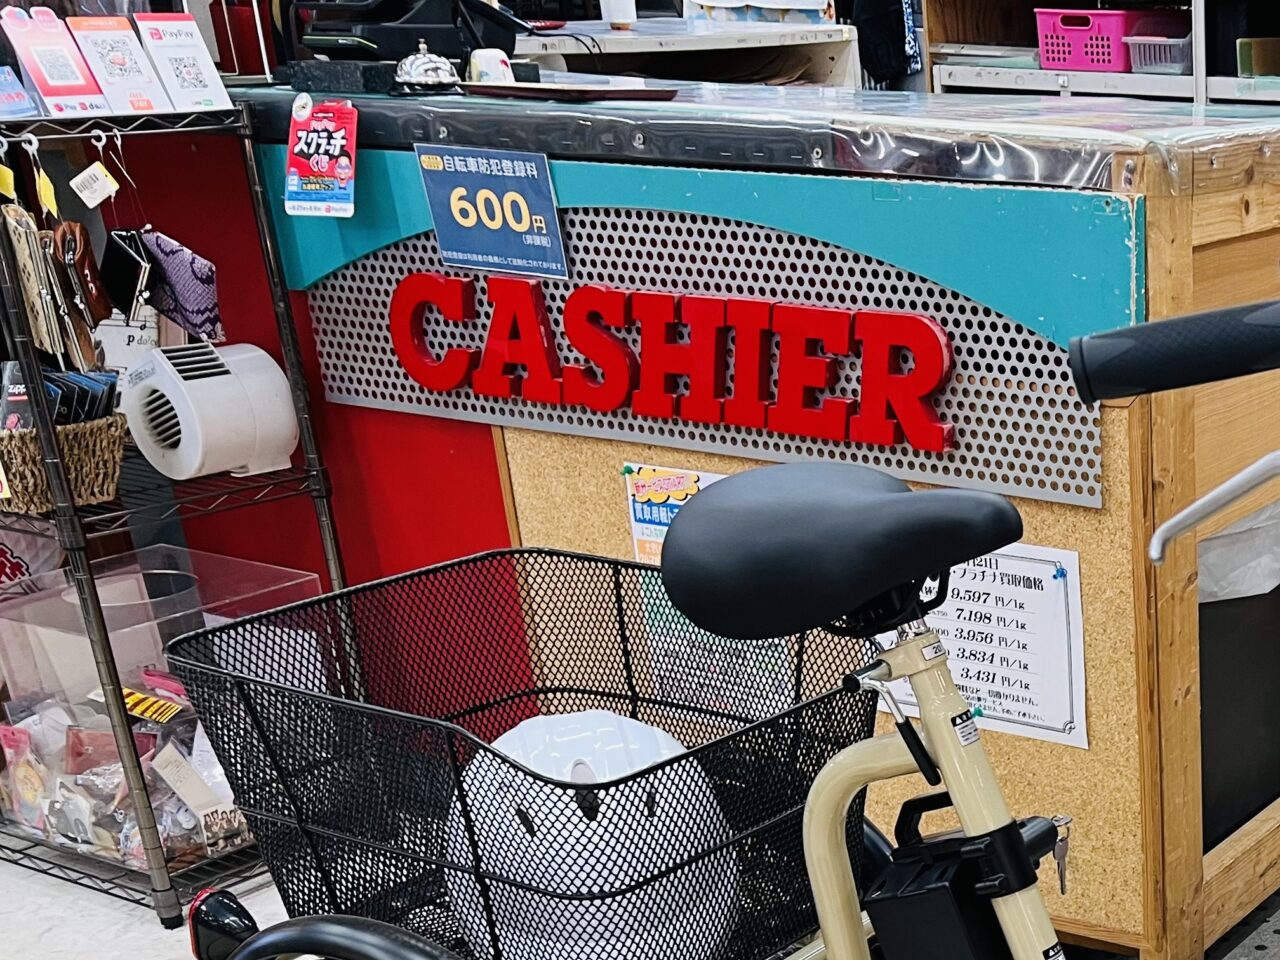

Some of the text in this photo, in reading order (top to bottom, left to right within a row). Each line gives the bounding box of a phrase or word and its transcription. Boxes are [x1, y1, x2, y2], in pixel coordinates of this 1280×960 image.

[162, 29, 194, 40] PayPay
[293, 128, 347, 156] スクラッチ
[309, 153, 329, 172] くじ
[443, 155, 538, 179] 自転車防犯登録料
[450, 186, 531, 233] 600
[532, 215, 547, 234] 円
[389, 272, 955, 452] CASHIER
